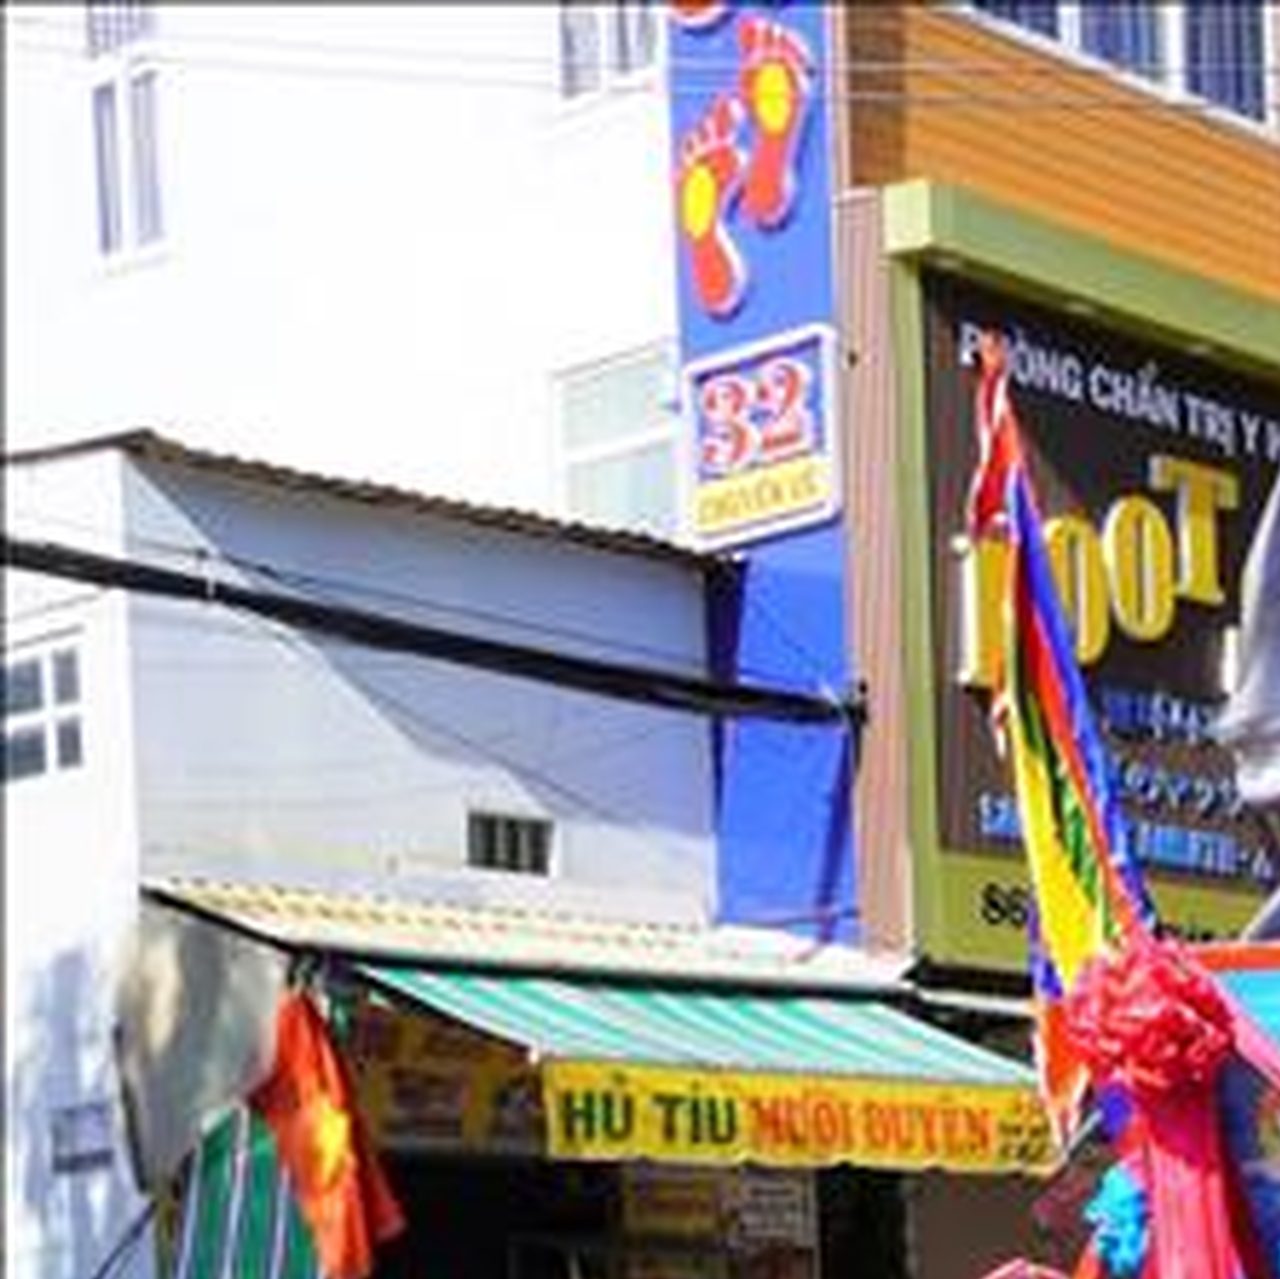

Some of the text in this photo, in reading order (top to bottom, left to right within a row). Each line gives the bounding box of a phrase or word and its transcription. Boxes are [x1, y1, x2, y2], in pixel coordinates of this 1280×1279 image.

[702, 358, 808, 470] 32
[958, 322, 1083, 399] PÒNG
[1241, 413, 1259, 453] Y
